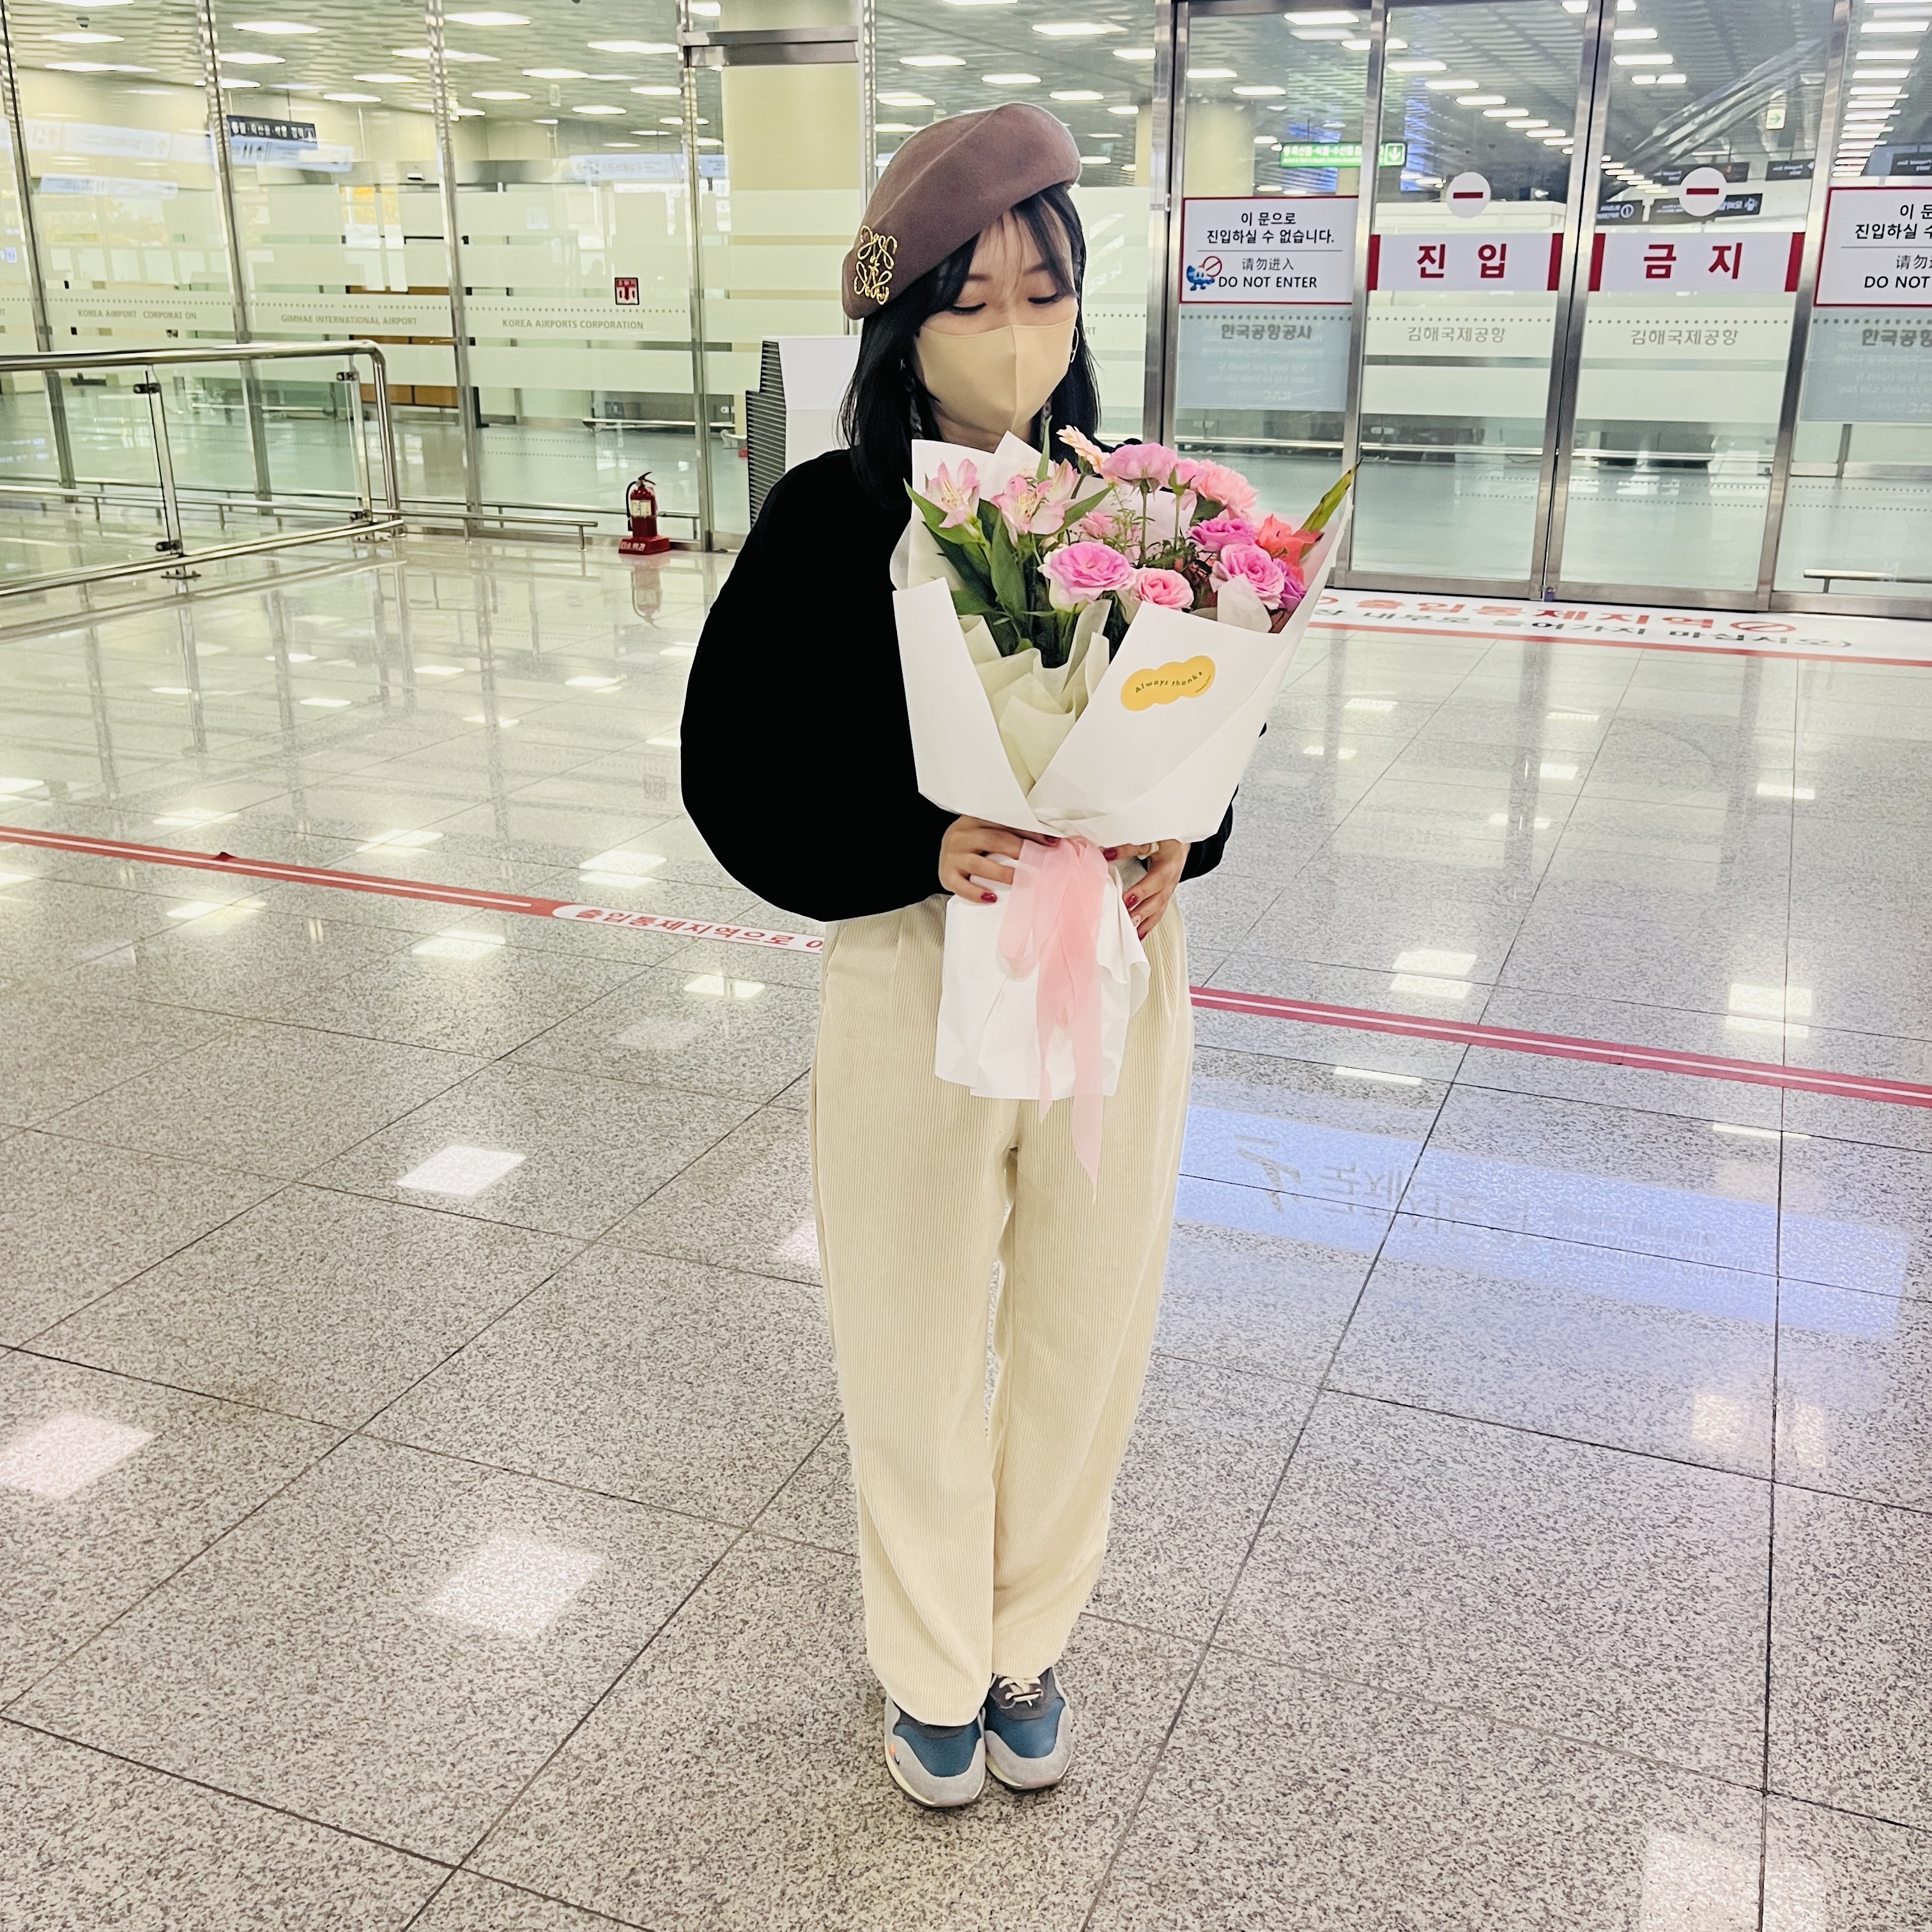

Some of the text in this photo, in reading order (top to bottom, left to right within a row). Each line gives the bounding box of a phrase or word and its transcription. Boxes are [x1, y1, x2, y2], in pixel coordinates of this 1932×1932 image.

[1241, 211, 1296, 226] 이 문으로
[1900, 203, 1914, 220] 이
[1207, 229, 1335, 244] 진입하실 수 없습니다.
[1855, 223, 1918, 240] 진입하실
[1241, 257, 1294, 271] 请勿进入
[1218, 276, 1317, 288] DO NOT ENTER
[1864, 275, 1931, 289] DO NOT
[77, 309, 103, 318] KOREA
[142, 310, 197, 320] CORPORATON
[280, 314, 417, 325] GIMHAE INTERNATIONAL AIRPORT
[502, 319, 644, 330] KOREA AIRPORTS CORPORATION
[1221, 323, 1314, 341] 한국공항공사
[1406, 326, 1506, 343] 김해국제공항
[1630, 328, 1740, 346] 김해국제공항
[1135, 679, 1169, 693] Always
[575, 908, 795, 946] 출입통제지역으로
